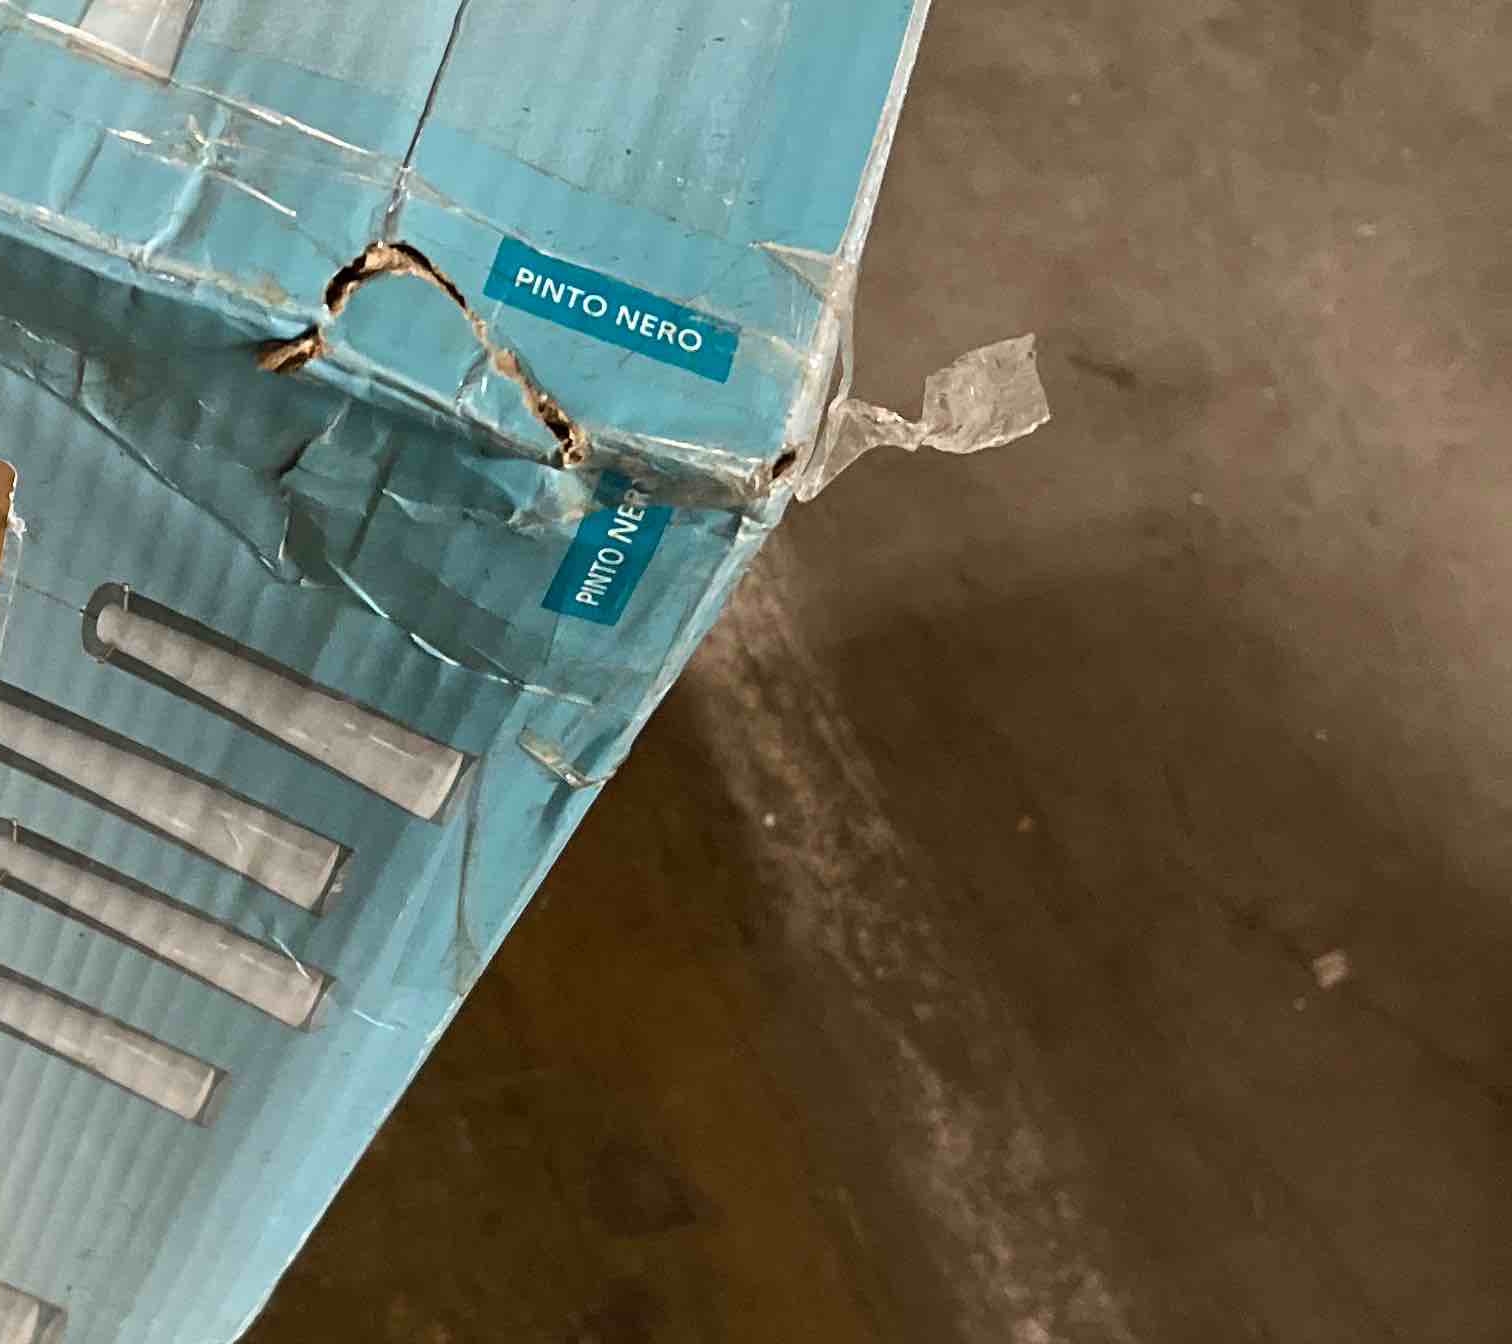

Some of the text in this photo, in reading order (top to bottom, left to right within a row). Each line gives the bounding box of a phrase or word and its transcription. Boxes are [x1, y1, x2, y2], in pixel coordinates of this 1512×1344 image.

[514, 266, 703, 353] PINTO NERO
[575, 479, 649, 607] PINTO NER
